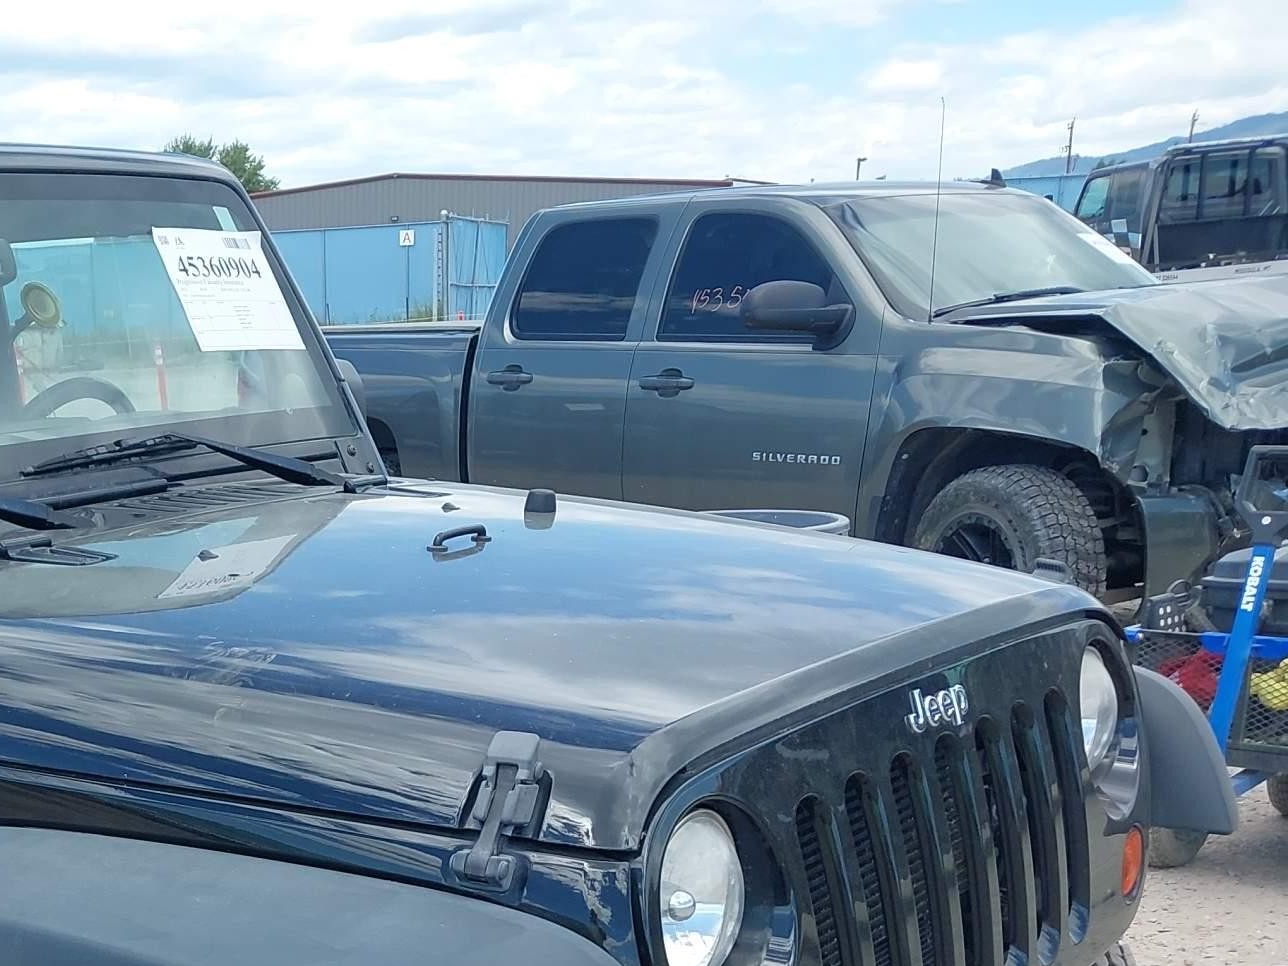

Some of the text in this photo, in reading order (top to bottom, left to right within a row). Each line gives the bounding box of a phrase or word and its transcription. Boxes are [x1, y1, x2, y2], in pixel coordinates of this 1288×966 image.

[403, 231, 411, 243] A
[178, 255, 262, 278] 45360904
[752, 452, 841, 465] SILVERADO
[1240, 556, 1265, 612] KOBALT
[904, 684, 969, 733] Jeep
